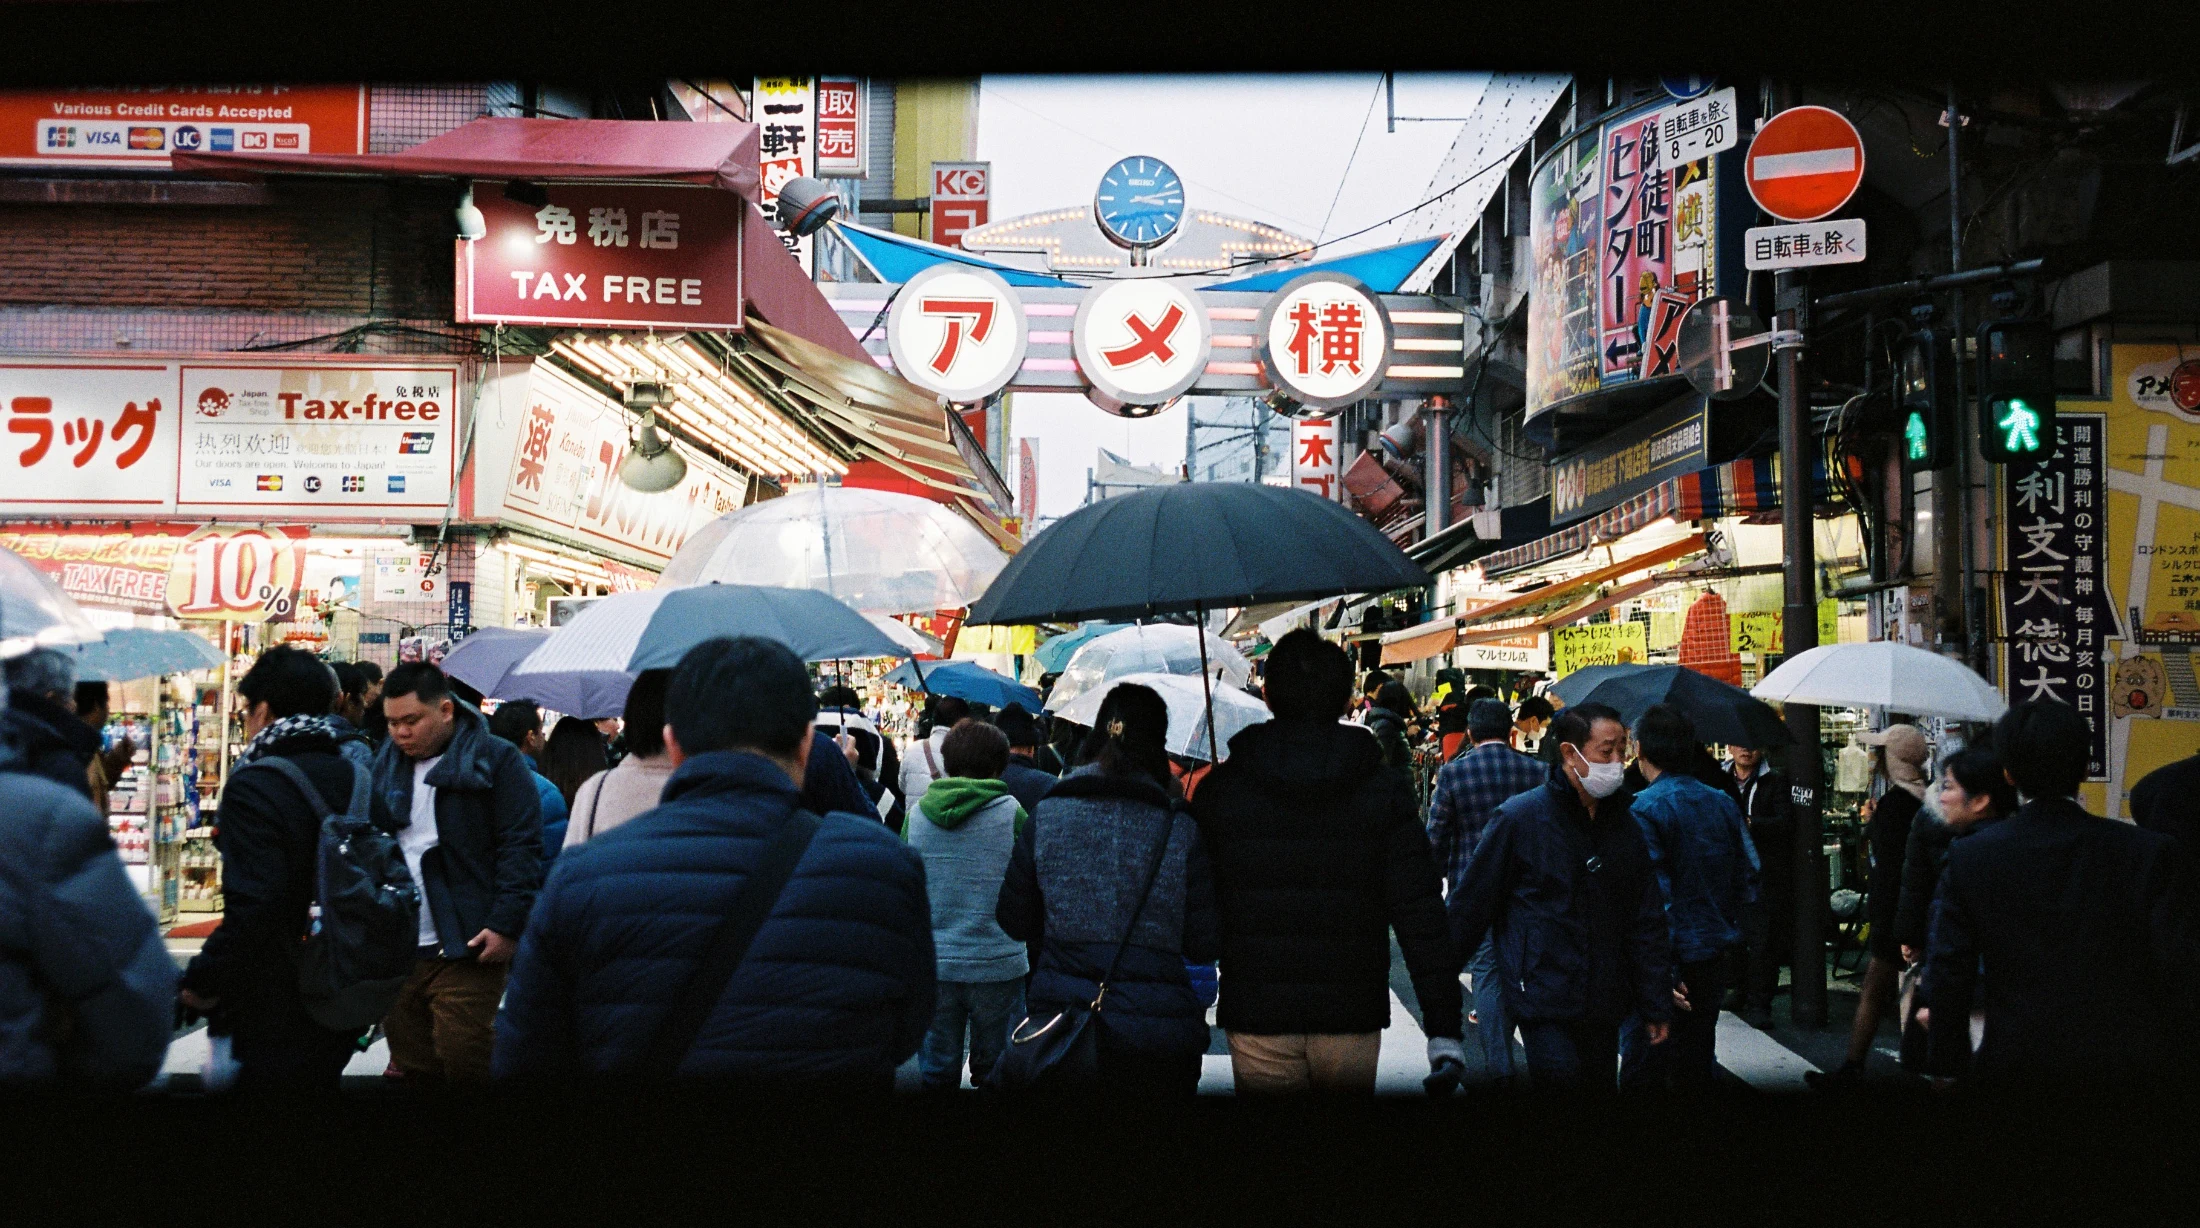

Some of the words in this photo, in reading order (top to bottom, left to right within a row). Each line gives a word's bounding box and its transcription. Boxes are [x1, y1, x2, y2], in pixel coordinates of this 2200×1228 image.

[54, 103, 112, 115] Various
[117, 103, 164, 116] Credit
[169, 104, 214, 117] Cards
[218, 105, 293, 120] Accepted
[1664, 102, 1729, 139] 自転車を除く
[86, 131, 122, 145] VISA
[243, 133, 266, 148] DC
[1671, 140, 1680, 160] 8
[1704, 125, 1724, 148] 20
[936, 170, 986, 195] KG
[1128, 179, 1155, 187] SEIKO
[1636, 121, 1671, 262] 御徒町
[535, 204, 681, 250] 免税店
[1604, 133, 1637, 324] センター
[1755, 230, 1857, 262] 自転車を除く
[510, 270, 587, 302] TAX
[603, 275, 703, 306] FREE
[920, 296, 1366, 379] アメ横
[278, 392, 441, 421] Tax-free
[396, 385, 441, 398] 免税店
[0, 397, 162, 470] ラッグ
[195, 432, 290, 456] 热烈欢迎
[516, 403, 555, 493] 薬
[209, 478, 232, 488] VISA
[2073, 425, 2094, 596] 開運勝利の守護神
[63, 563, 108, 592] TAX
[109, 568, 168, 600] FREE
[180, 532, 290, 614] 10%
[2013, 425, 2072, 704] 利支天徳大
[1476, 648, 1529, 663] マルセル店
[2074, 605, 2096, 757] 毎月亥の日
